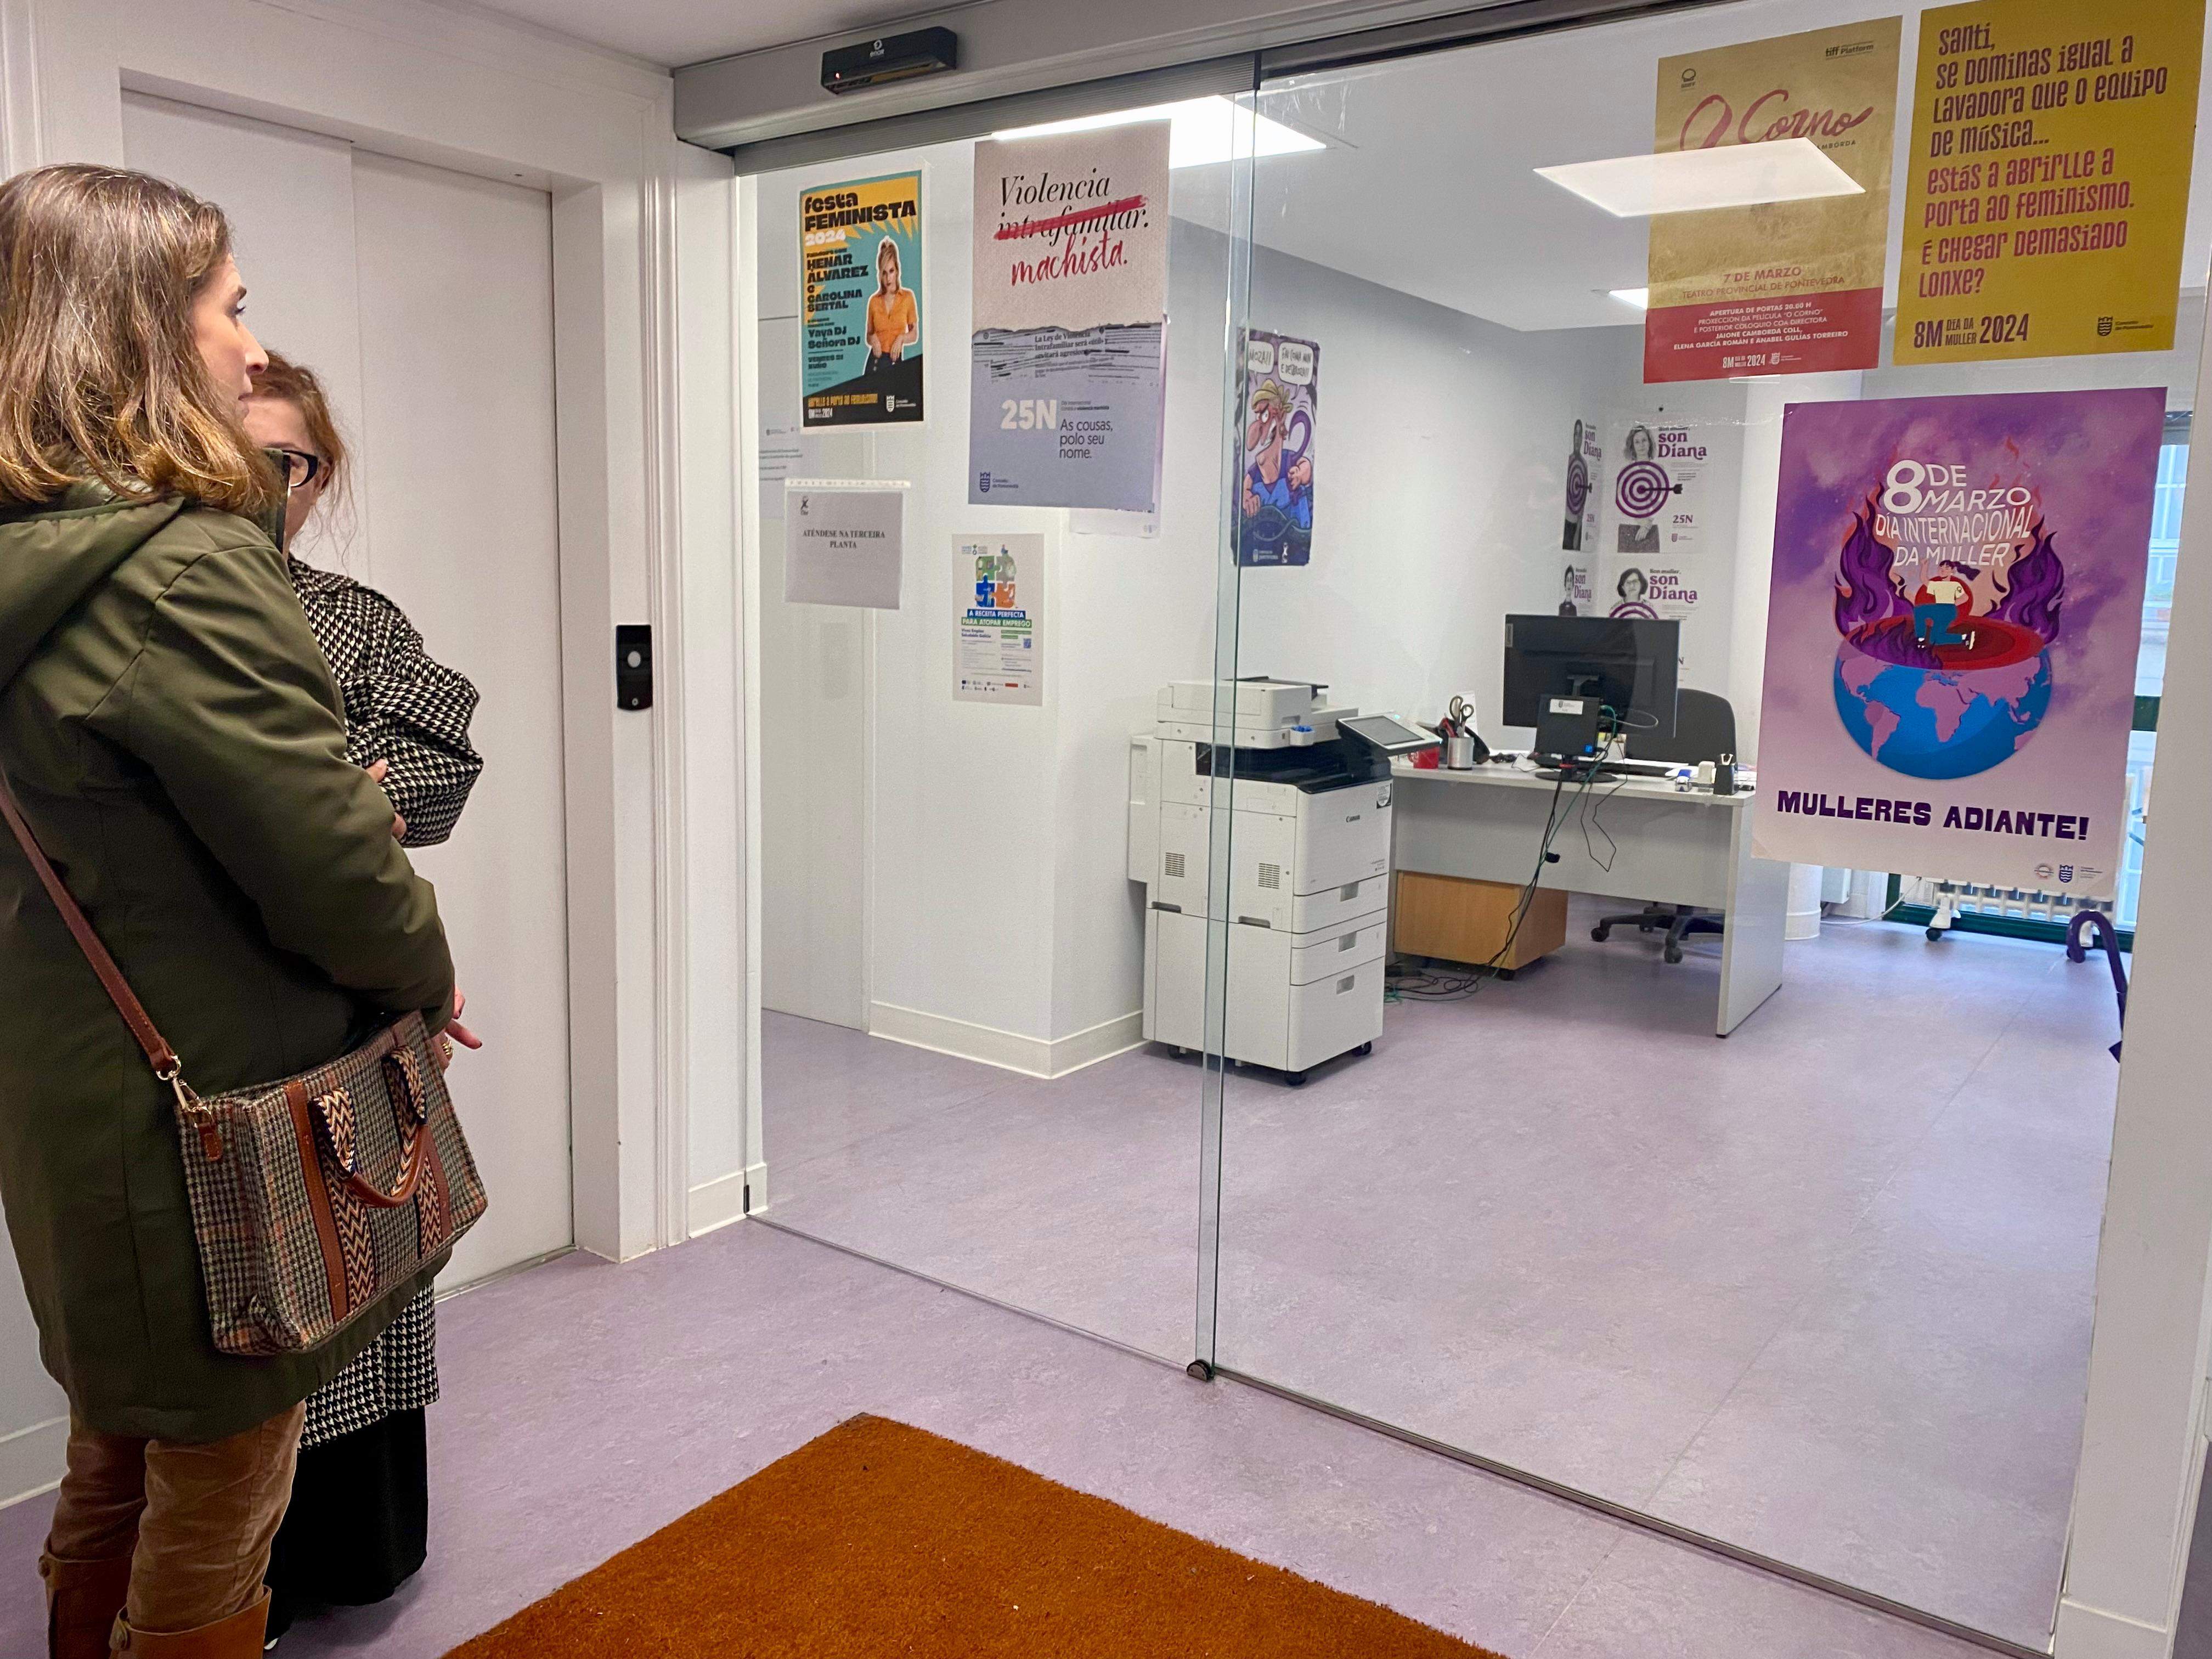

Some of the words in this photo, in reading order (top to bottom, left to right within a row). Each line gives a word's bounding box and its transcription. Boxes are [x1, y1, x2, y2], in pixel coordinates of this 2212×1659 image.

[1737, 89, 1874, 144] Corno
[1001, 167, 1110, 206] Violencia
[805, 200, 916, 232] FEMINISTA
[808, 253, 852, 270] HENAR
[1012, 230, 1127, 286] machista.
[1724, 274, 1731, 283] 7
[1734, 272, 1750, 282] DE
[1754, 267, 1801, 280] MARZO
[1683, 289, 1713, 298] TEATRO
[1716, 284, 1767, 295] PROVINCIAL
[1785, 276, 1844, 289] PONTEVEDRA
[808, 289, 862, 303] CAROLINA
[1710, 308, 1743, 317] APERTURA
[834, 326, 847, 335] DJ
[1699, 324, 1733, 332] POSTERIOR
[1735, 322, 1771, 330] COLOQUIO
[1790, 317, 1827, 325] DIRECTORA
[1914, 319, 1944, 348] 8M
[1979, 313, 2029, 343] 2024
[1963, 318, 1974, 330] DA
[1716, 331, 1740, 339] JAIONE
[1742, 329, 1781, 337] CAMBORDA
[1813, 331, 1848, 339] TORREIRO
[1945, 332, 1977, 346] MULLER
[808, 338, 846, 349] Señora
[848, 336, 860, 345] DJ
[1723, 357, 1734, 368] 8M
[1747, 354, 1766, 366] 2024
[1001, 399, 1057, 430] 25N
[1060, 419, 1074, 431] As
[1076, 421, 1113, 432] cousas,
[1060, 433, 1085, 447] polo
[1087, 435, 1104, 444] seu
[1658, 432, 1688, 443] son
[1059, 449, 1092, 458] nome.
[1584, 441, 1602, 461] Diana
[1658, 443, 1707, 460] Diana
[1883, 460, 1926, 514] 8
[1925, 464, 1967, 487] DE
[1915, 487, 2031, 514] MARZO
[1673, 515, 1694, 523] 25N
[1876, 512, 1902, 540] DÍA
[1901, 504, 2034, 544] INTERNACIONAL
[803, 528, 837, 537] ATÉNDESE
[1893, 546, 1918, 566] DA
[1927, 543, 2010, 566] MULLER
[1650, 575, 1678, 585] son
[1649, 586, 1697, 603] Diana
[1778, 791, 1931, 826] MULLERES
[1943, 805, 2089, 840] ADIANTE!
